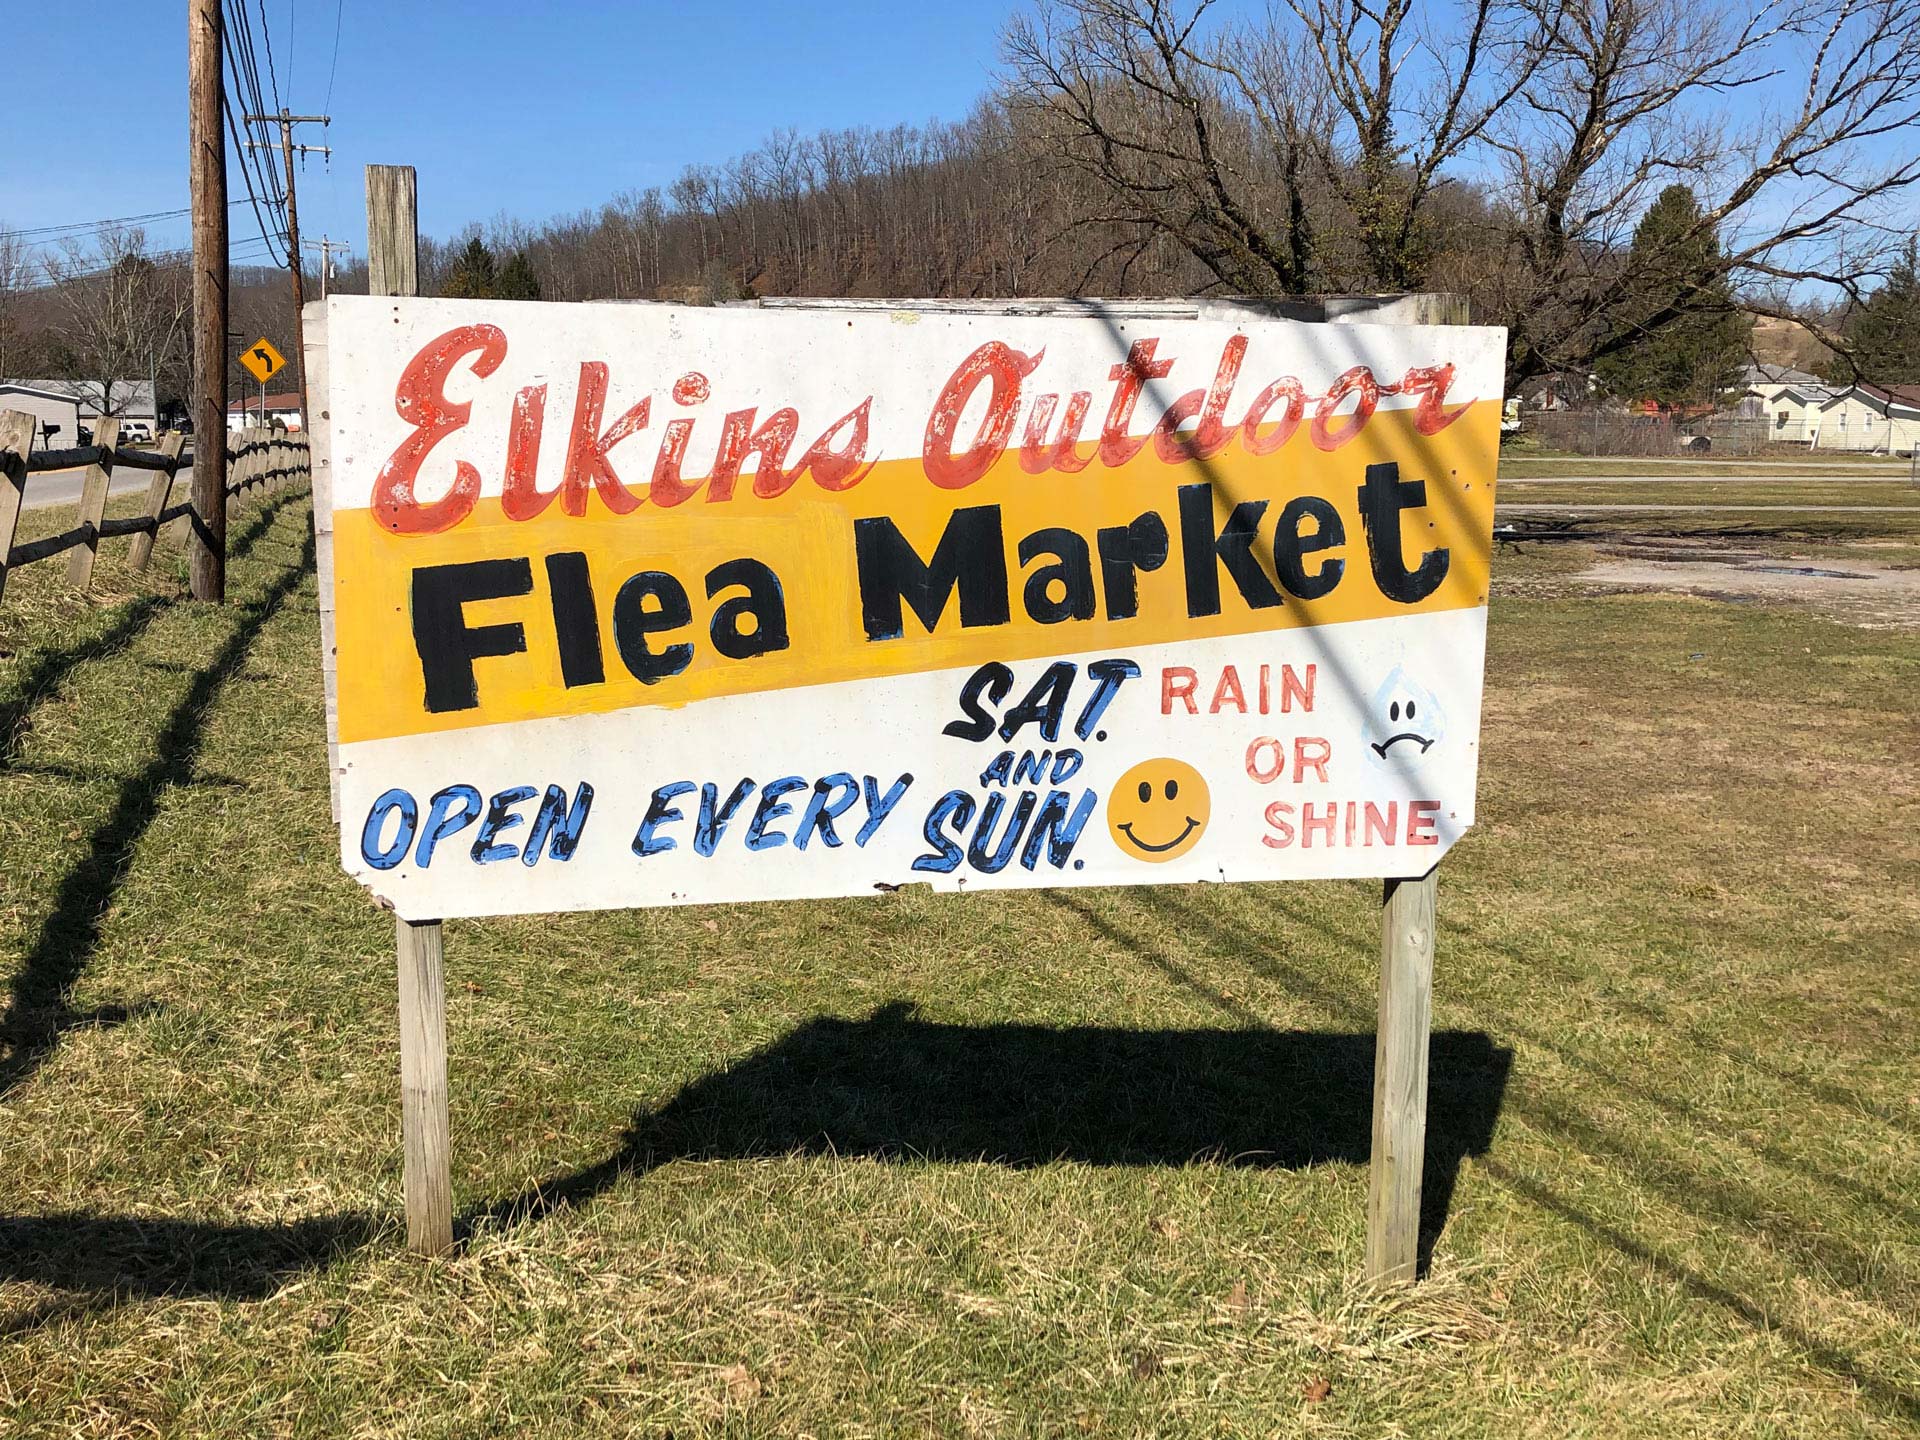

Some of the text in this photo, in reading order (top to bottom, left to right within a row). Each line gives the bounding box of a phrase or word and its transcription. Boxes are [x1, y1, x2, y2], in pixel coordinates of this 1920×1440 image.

[371, 323, 1478, 537] Elkins Outdoor
[411, 462, 1450, 713] Flea Market
[942, 658, 1142, 744] SAT.
[1161, 663, 1317, 715] RAIN
[979, 748, 1084, 788] AND
[1245, 736, 1332, 784] OR
[360, 771, 914, 871] OPEN EVERY
[911, 787, 1098, 874] SUN.
[1262, 800, 1441, 849] SHINE
